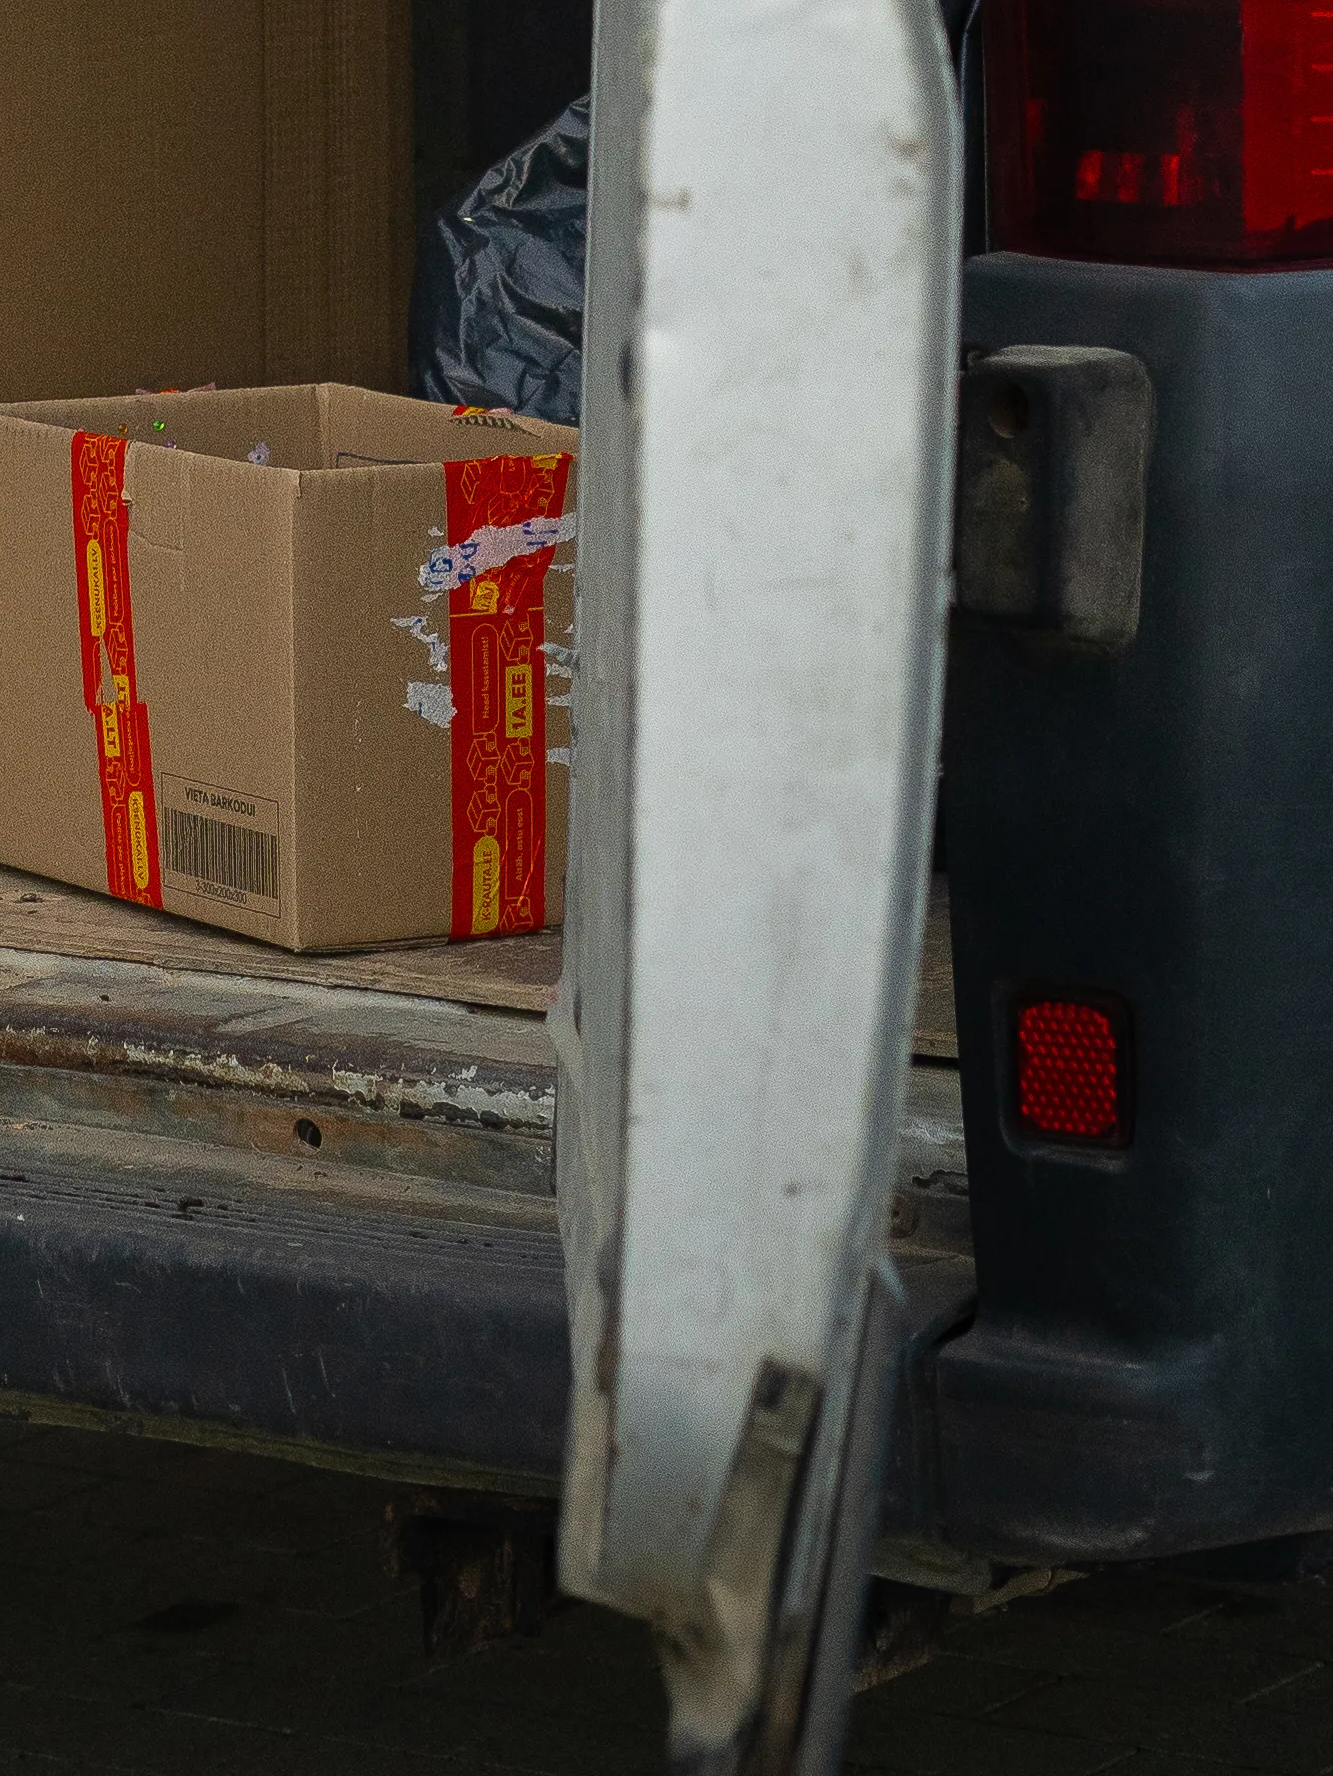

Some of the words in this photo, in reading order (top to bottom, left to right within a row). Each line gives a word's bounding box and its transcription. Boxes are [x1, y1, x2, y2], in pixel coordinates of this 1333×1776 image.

[104, 705, 117, 749] A.LT
[511, 672, 527, 731] 1A.EE
[184, 786, 209, 805] VIETA
[210, 793, 257, 818] BARKODUI
[481, 850, 493, 922] K-RAUTA.EE
